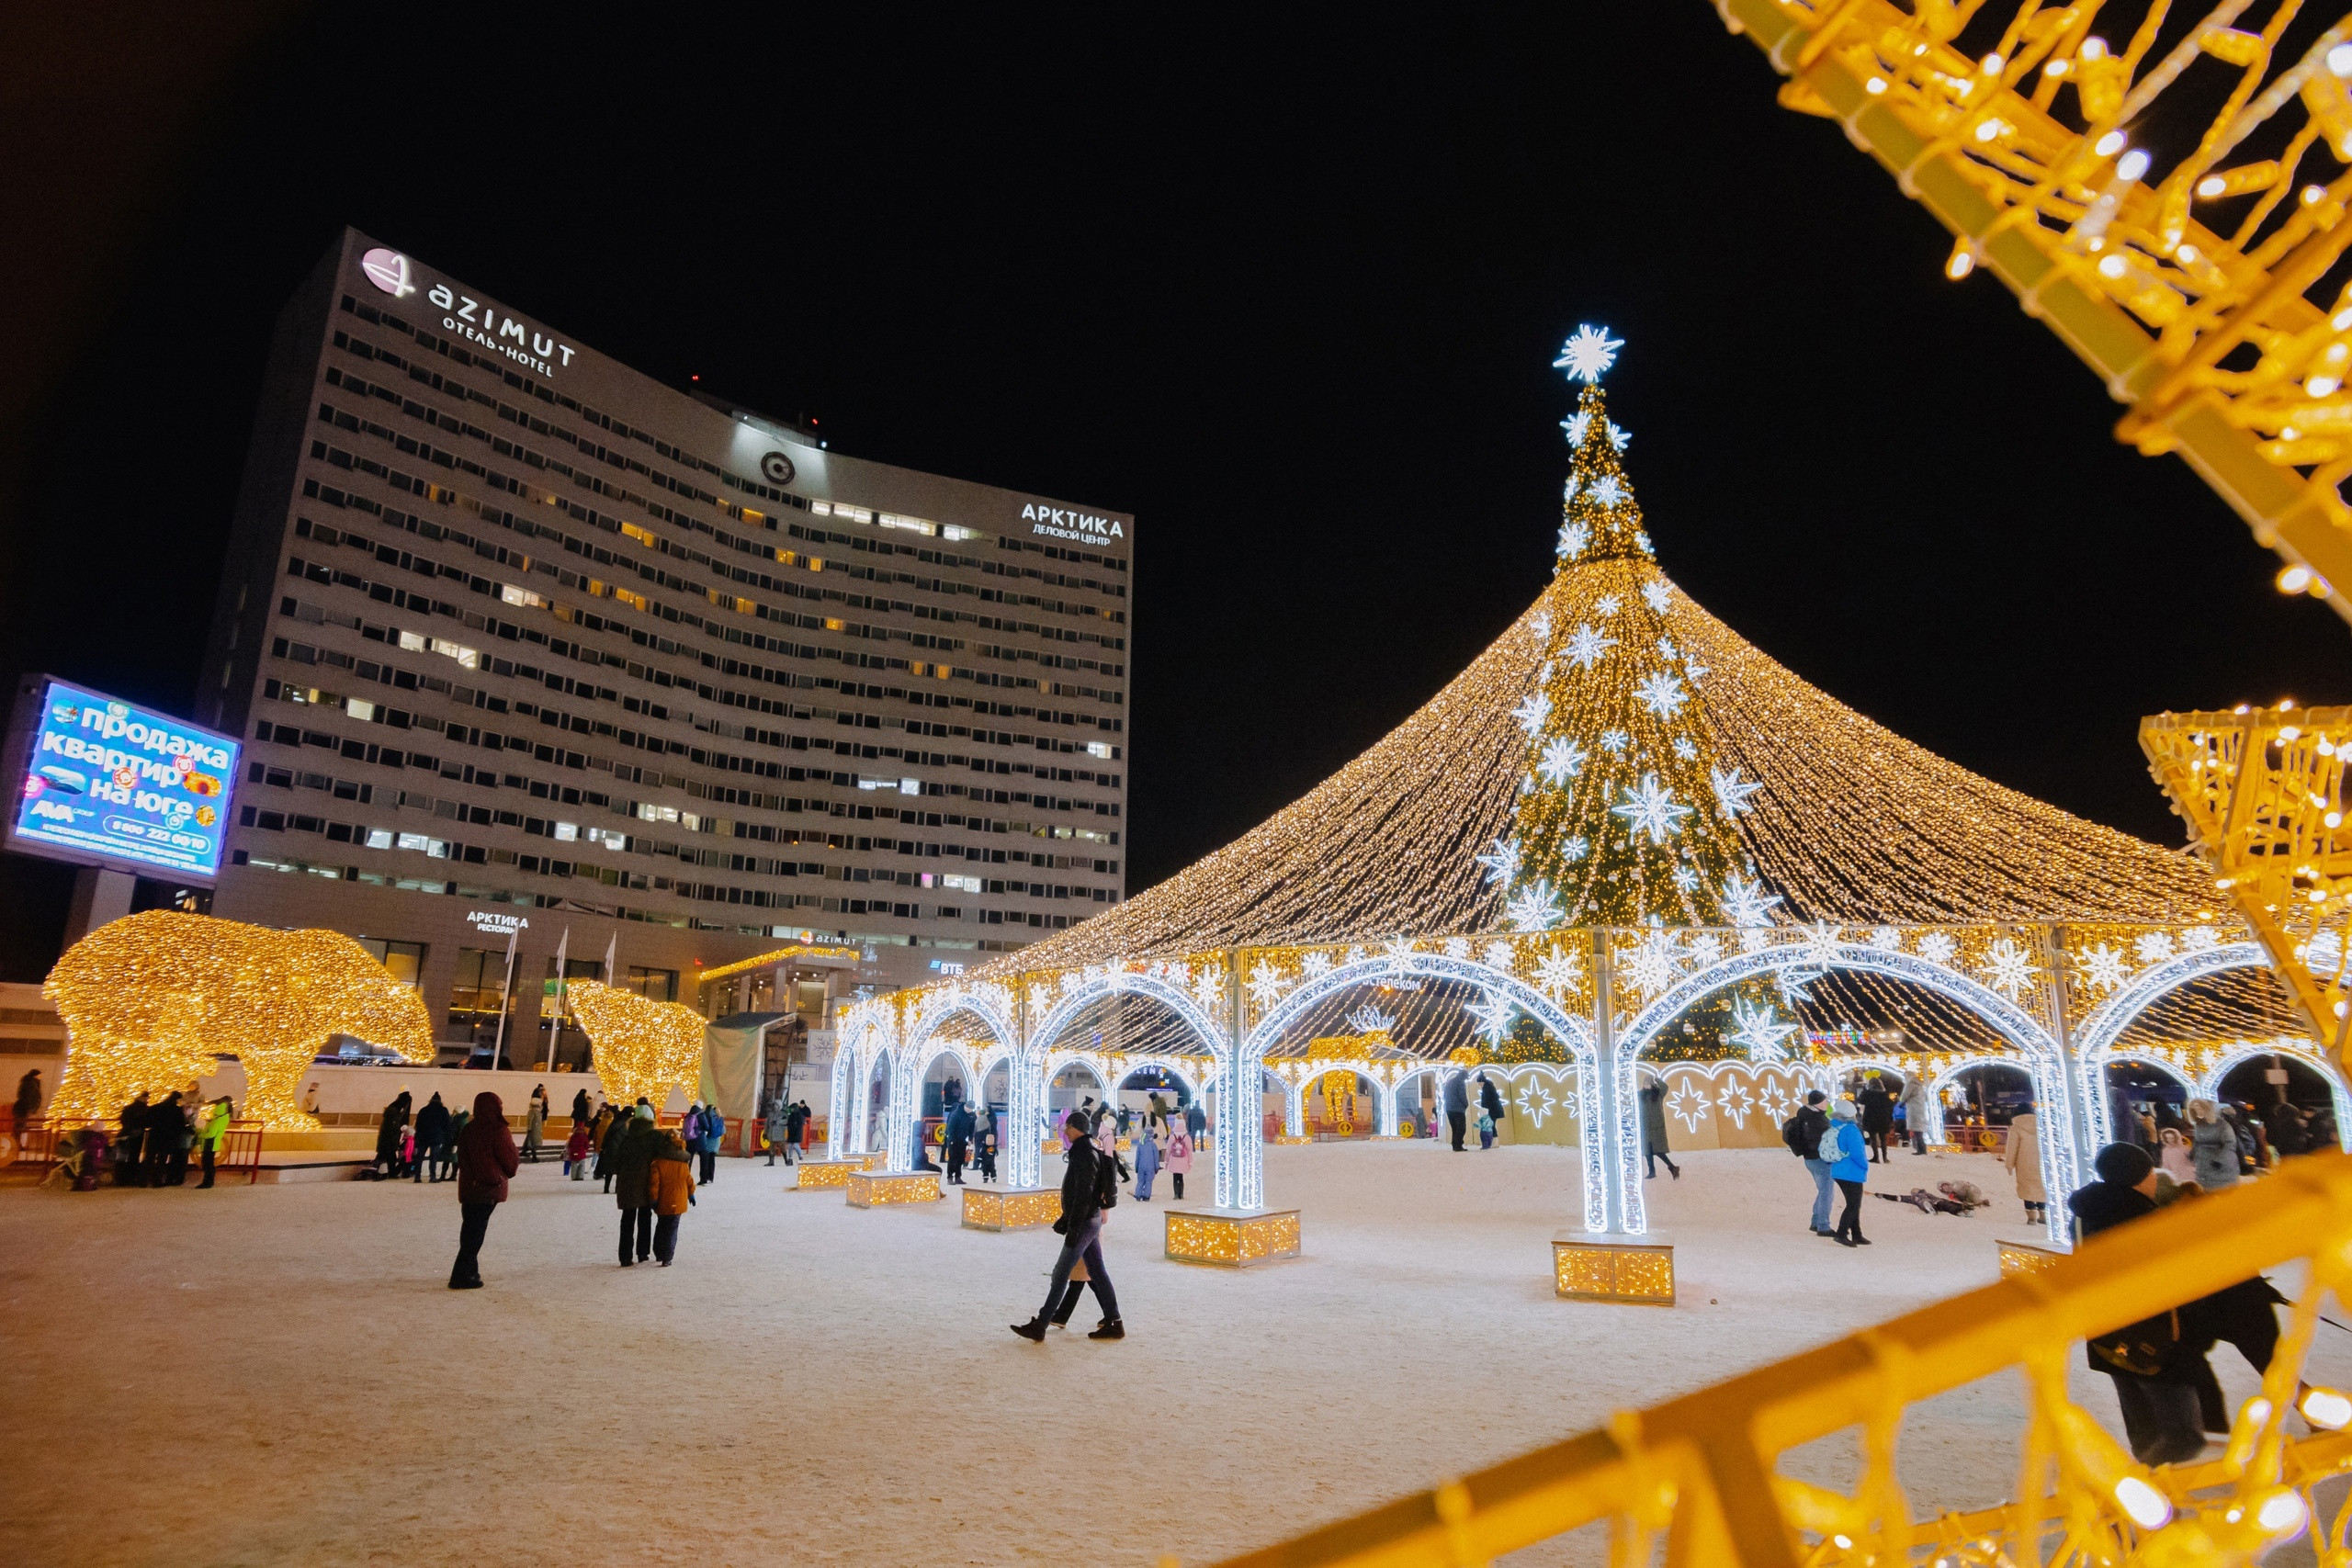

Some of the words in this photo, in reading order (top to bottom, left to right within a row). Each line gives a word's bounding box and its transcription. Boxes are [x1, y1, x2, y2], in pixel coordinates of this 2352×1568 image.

[442, 317, 496, 350] ОТЕЛЬ
[505, 345, 553, 378] HOTEL
[1021, 502, 1124, 538] АРКТИКА
[1033, 524, 1080, 540] ДЕЛОВОЙ
[1080, 533, 1111, 547] ЦЕНТР
[81, 707, 229, 770] продажа
[42, 730, 183, 788] квартир
[30, 799, 75, 823] AVA
[89, 778, 130, 806] на
[133, 790, 194, 820] юге
[467, 910, 529, 929] АРКТИКА
[940, 963, 964, 975] ВТБ
